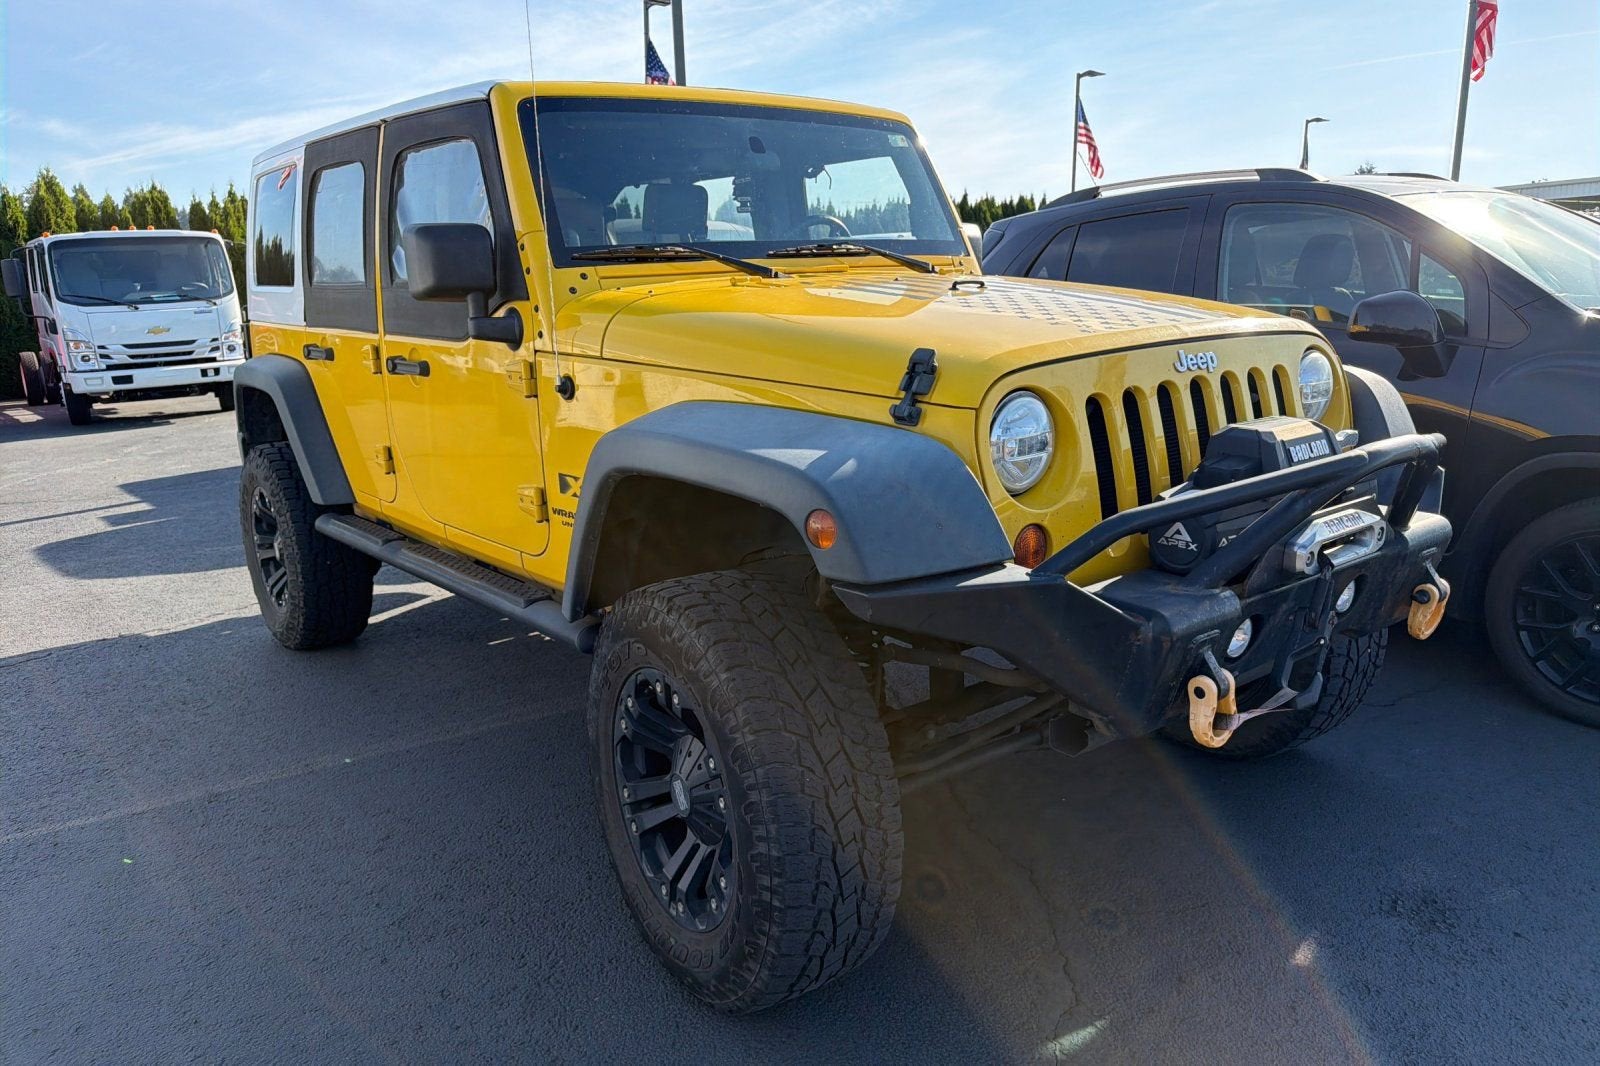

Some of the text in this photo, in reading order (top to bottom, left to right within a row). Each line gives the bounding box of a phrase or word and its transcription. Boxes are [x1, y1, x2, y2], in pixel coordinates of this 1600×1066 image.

[1174, 349, 1218, 373] Jeep
[1289, 438, 1330, 463] BADLAND
[552, 506, 577, 519] WRA
[561, 520, 574, 528] UN
[1157, 537, 1198, 551] APEX
